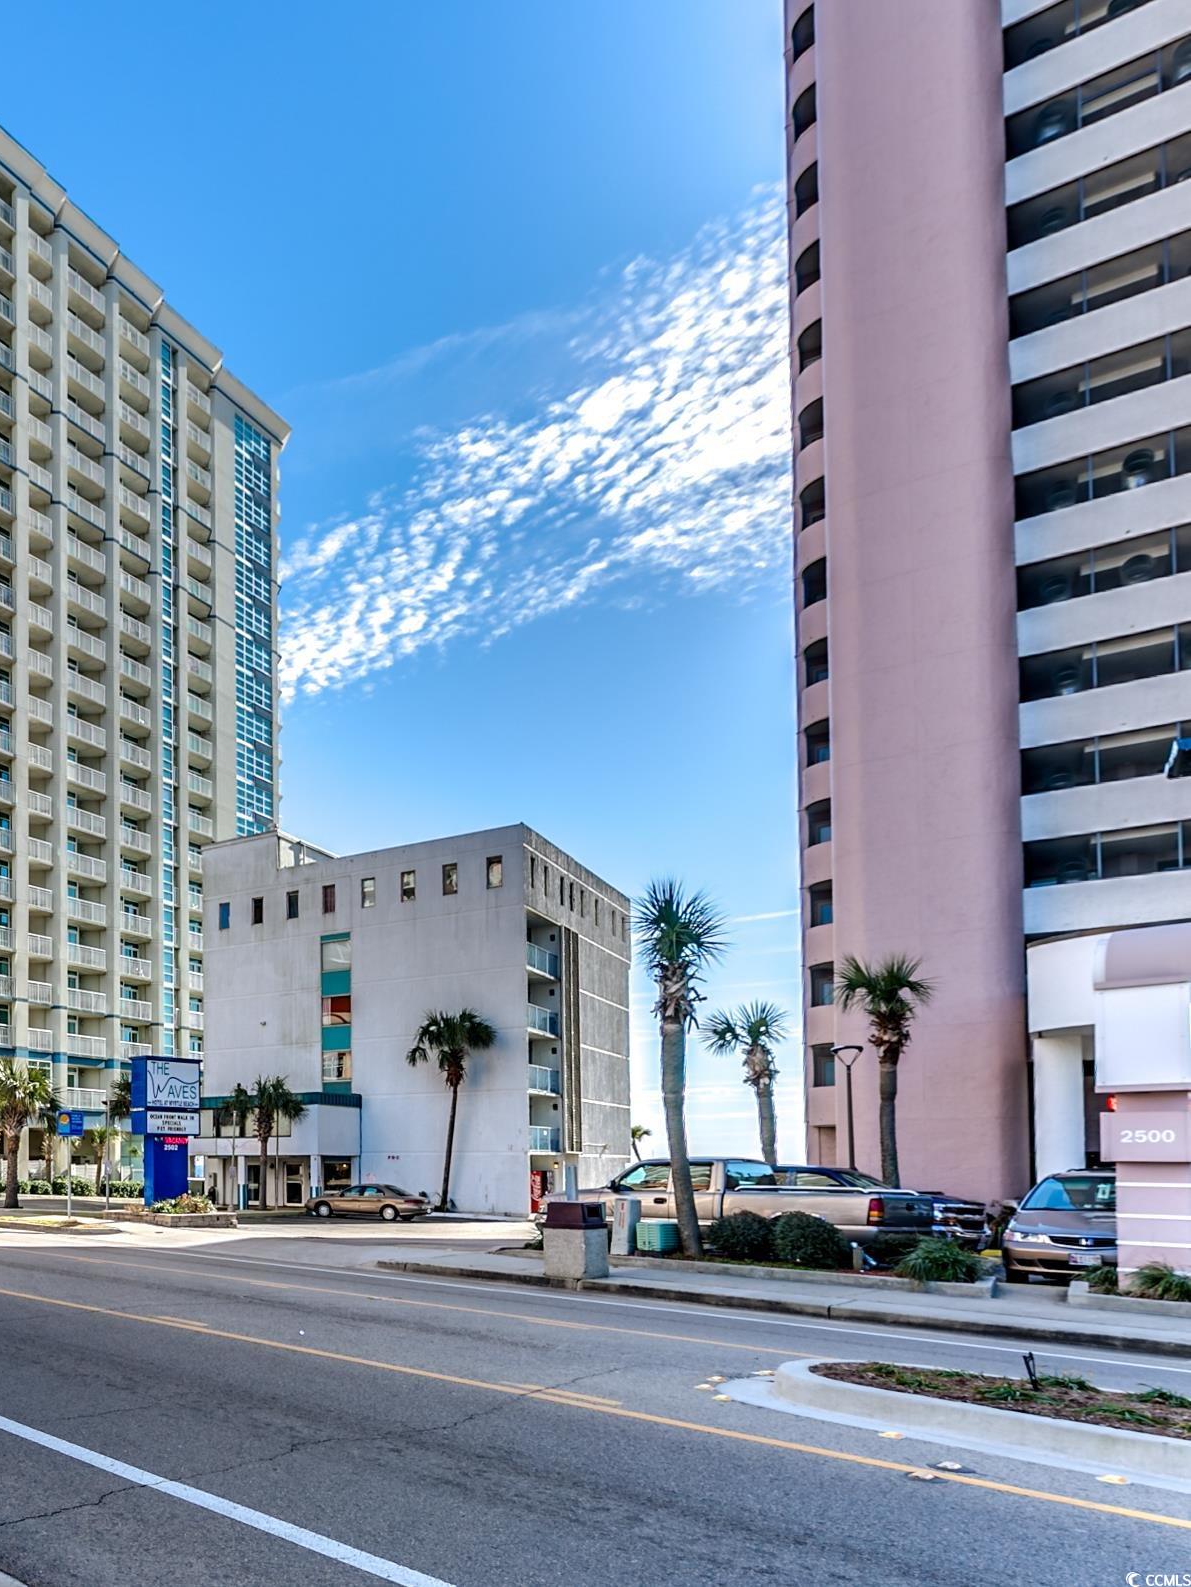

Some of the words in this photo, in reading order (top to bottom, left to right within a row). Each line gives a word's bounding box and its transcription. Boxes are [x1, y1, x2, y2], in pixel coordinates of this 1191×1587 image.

[151, 1061, 170, 1076] THE
[148, 1073, 197, 1100] WAVES
[1120, 1129, 1176, 1143] 2500
